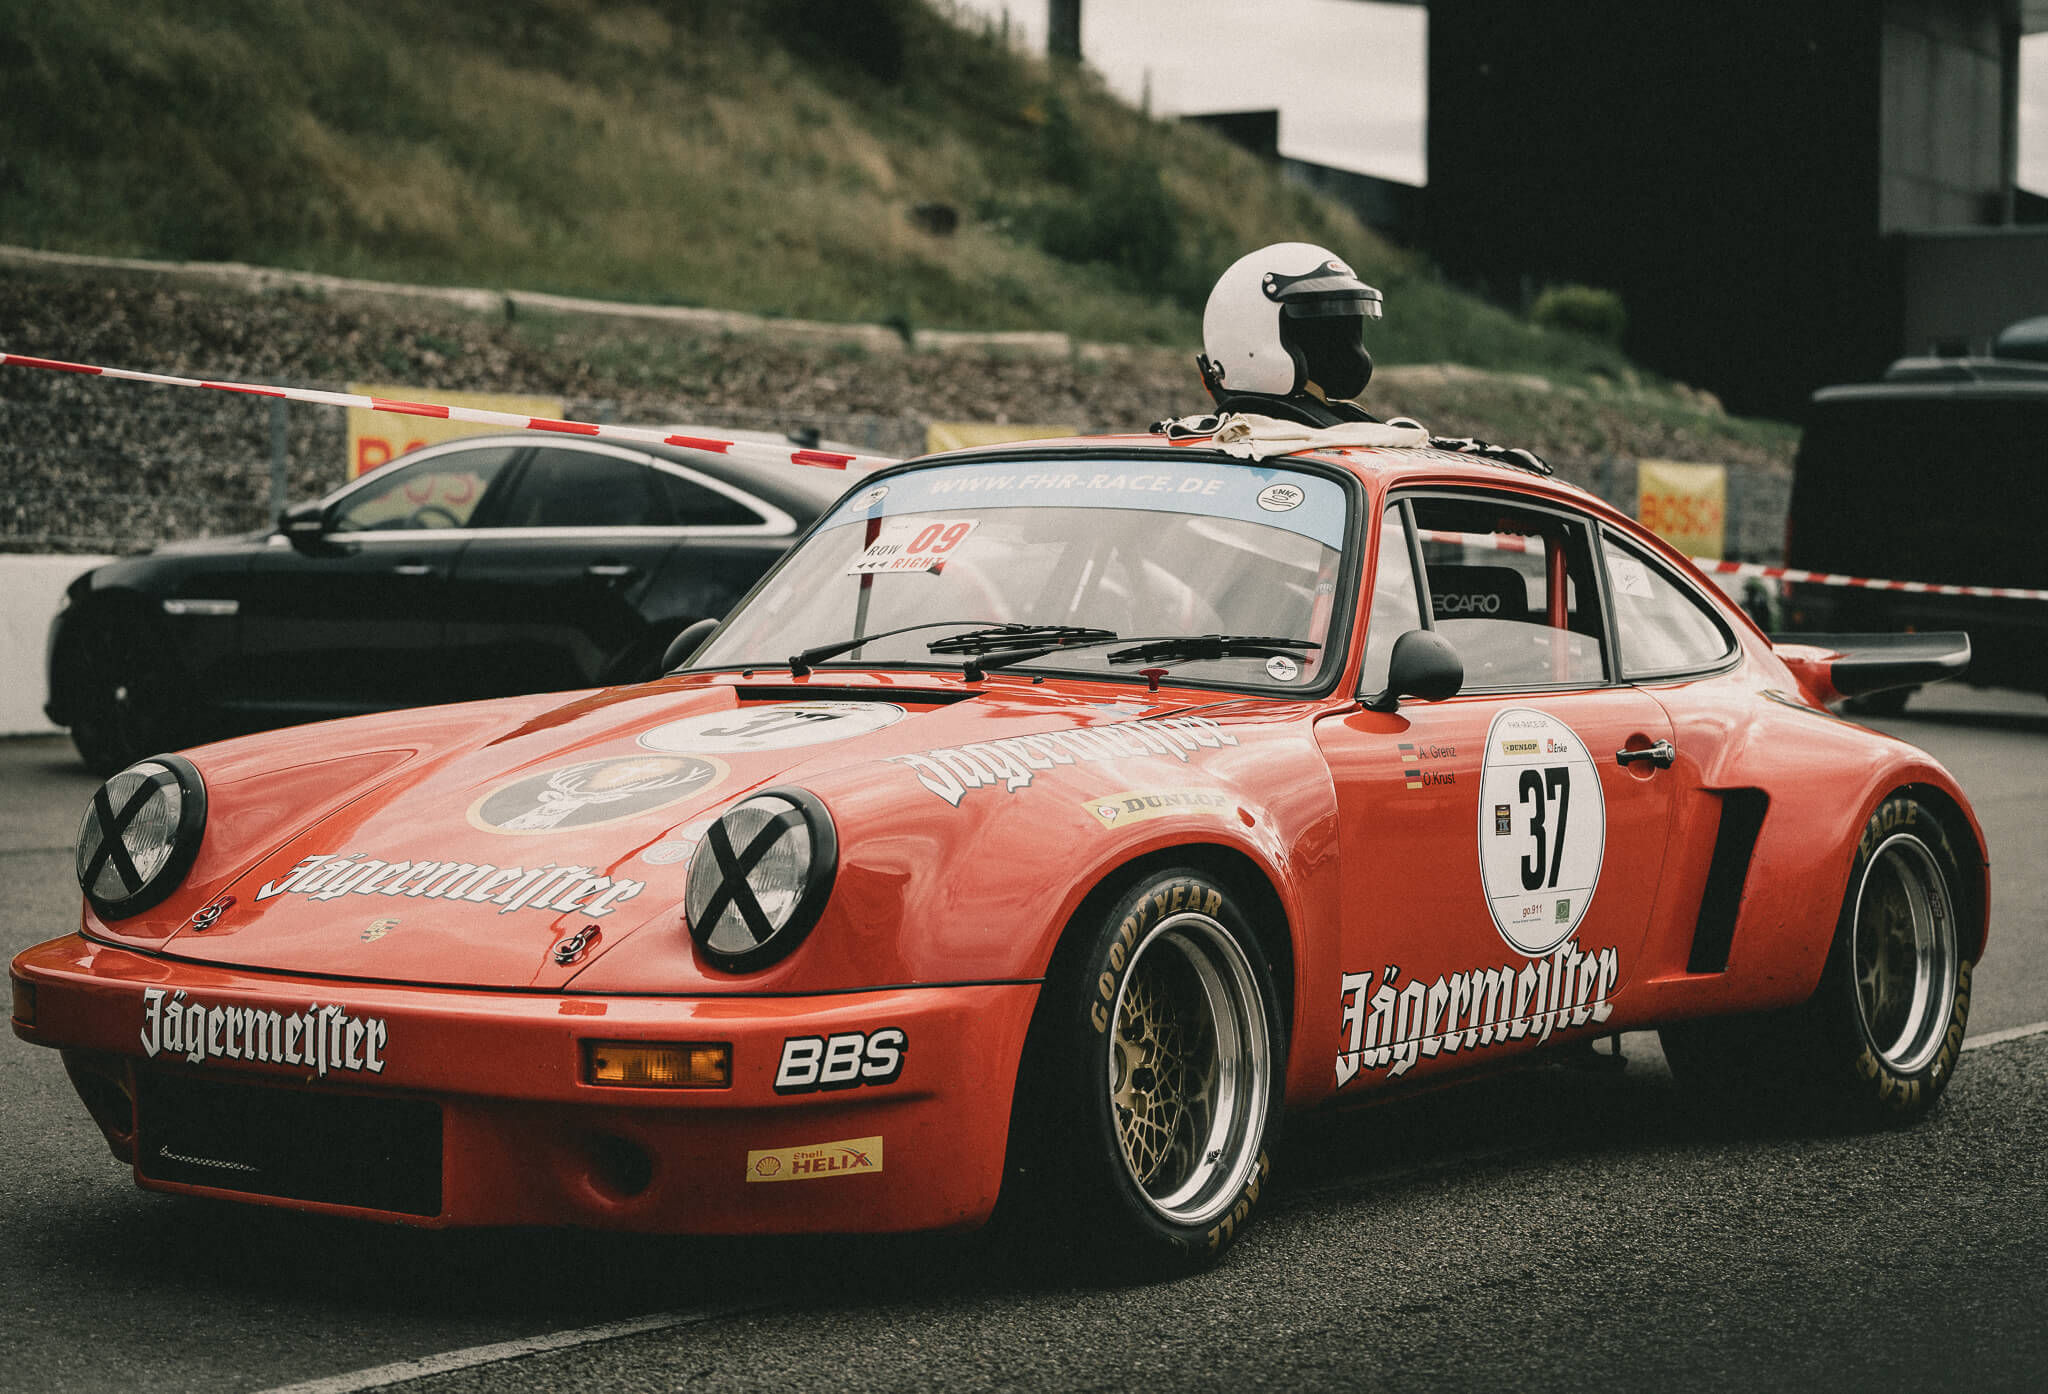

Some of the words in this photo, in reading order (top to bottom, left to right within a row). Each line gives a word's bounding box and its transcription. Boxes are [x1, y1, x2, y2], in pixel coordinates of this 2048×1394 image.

[930, 474, 1225, 496] WWW.FHR-RACE.DE
[867, 544, 903, 556] ROW
[906, 523, 970, 554] 09
[890, 557, 946, 569] RIGHT
[1432, 594, 1500, 613] ECARO
[1126, 794, 1227, 813] DUNLOP
[1519, 767, 1570, 891] 37
[1860, 799, 1918, 863] EAGLE
[255, 853, 646, 918] Jägermeister
[1335, 936, 1618, 1089] Jägermeister
[140, 986, 388, 1078] Jägermeister
[774, 1027, 907, 1094] BBS
[792, 1152, 870, 1174] HELIX
[793, 1150, 823, 1160] Shell
